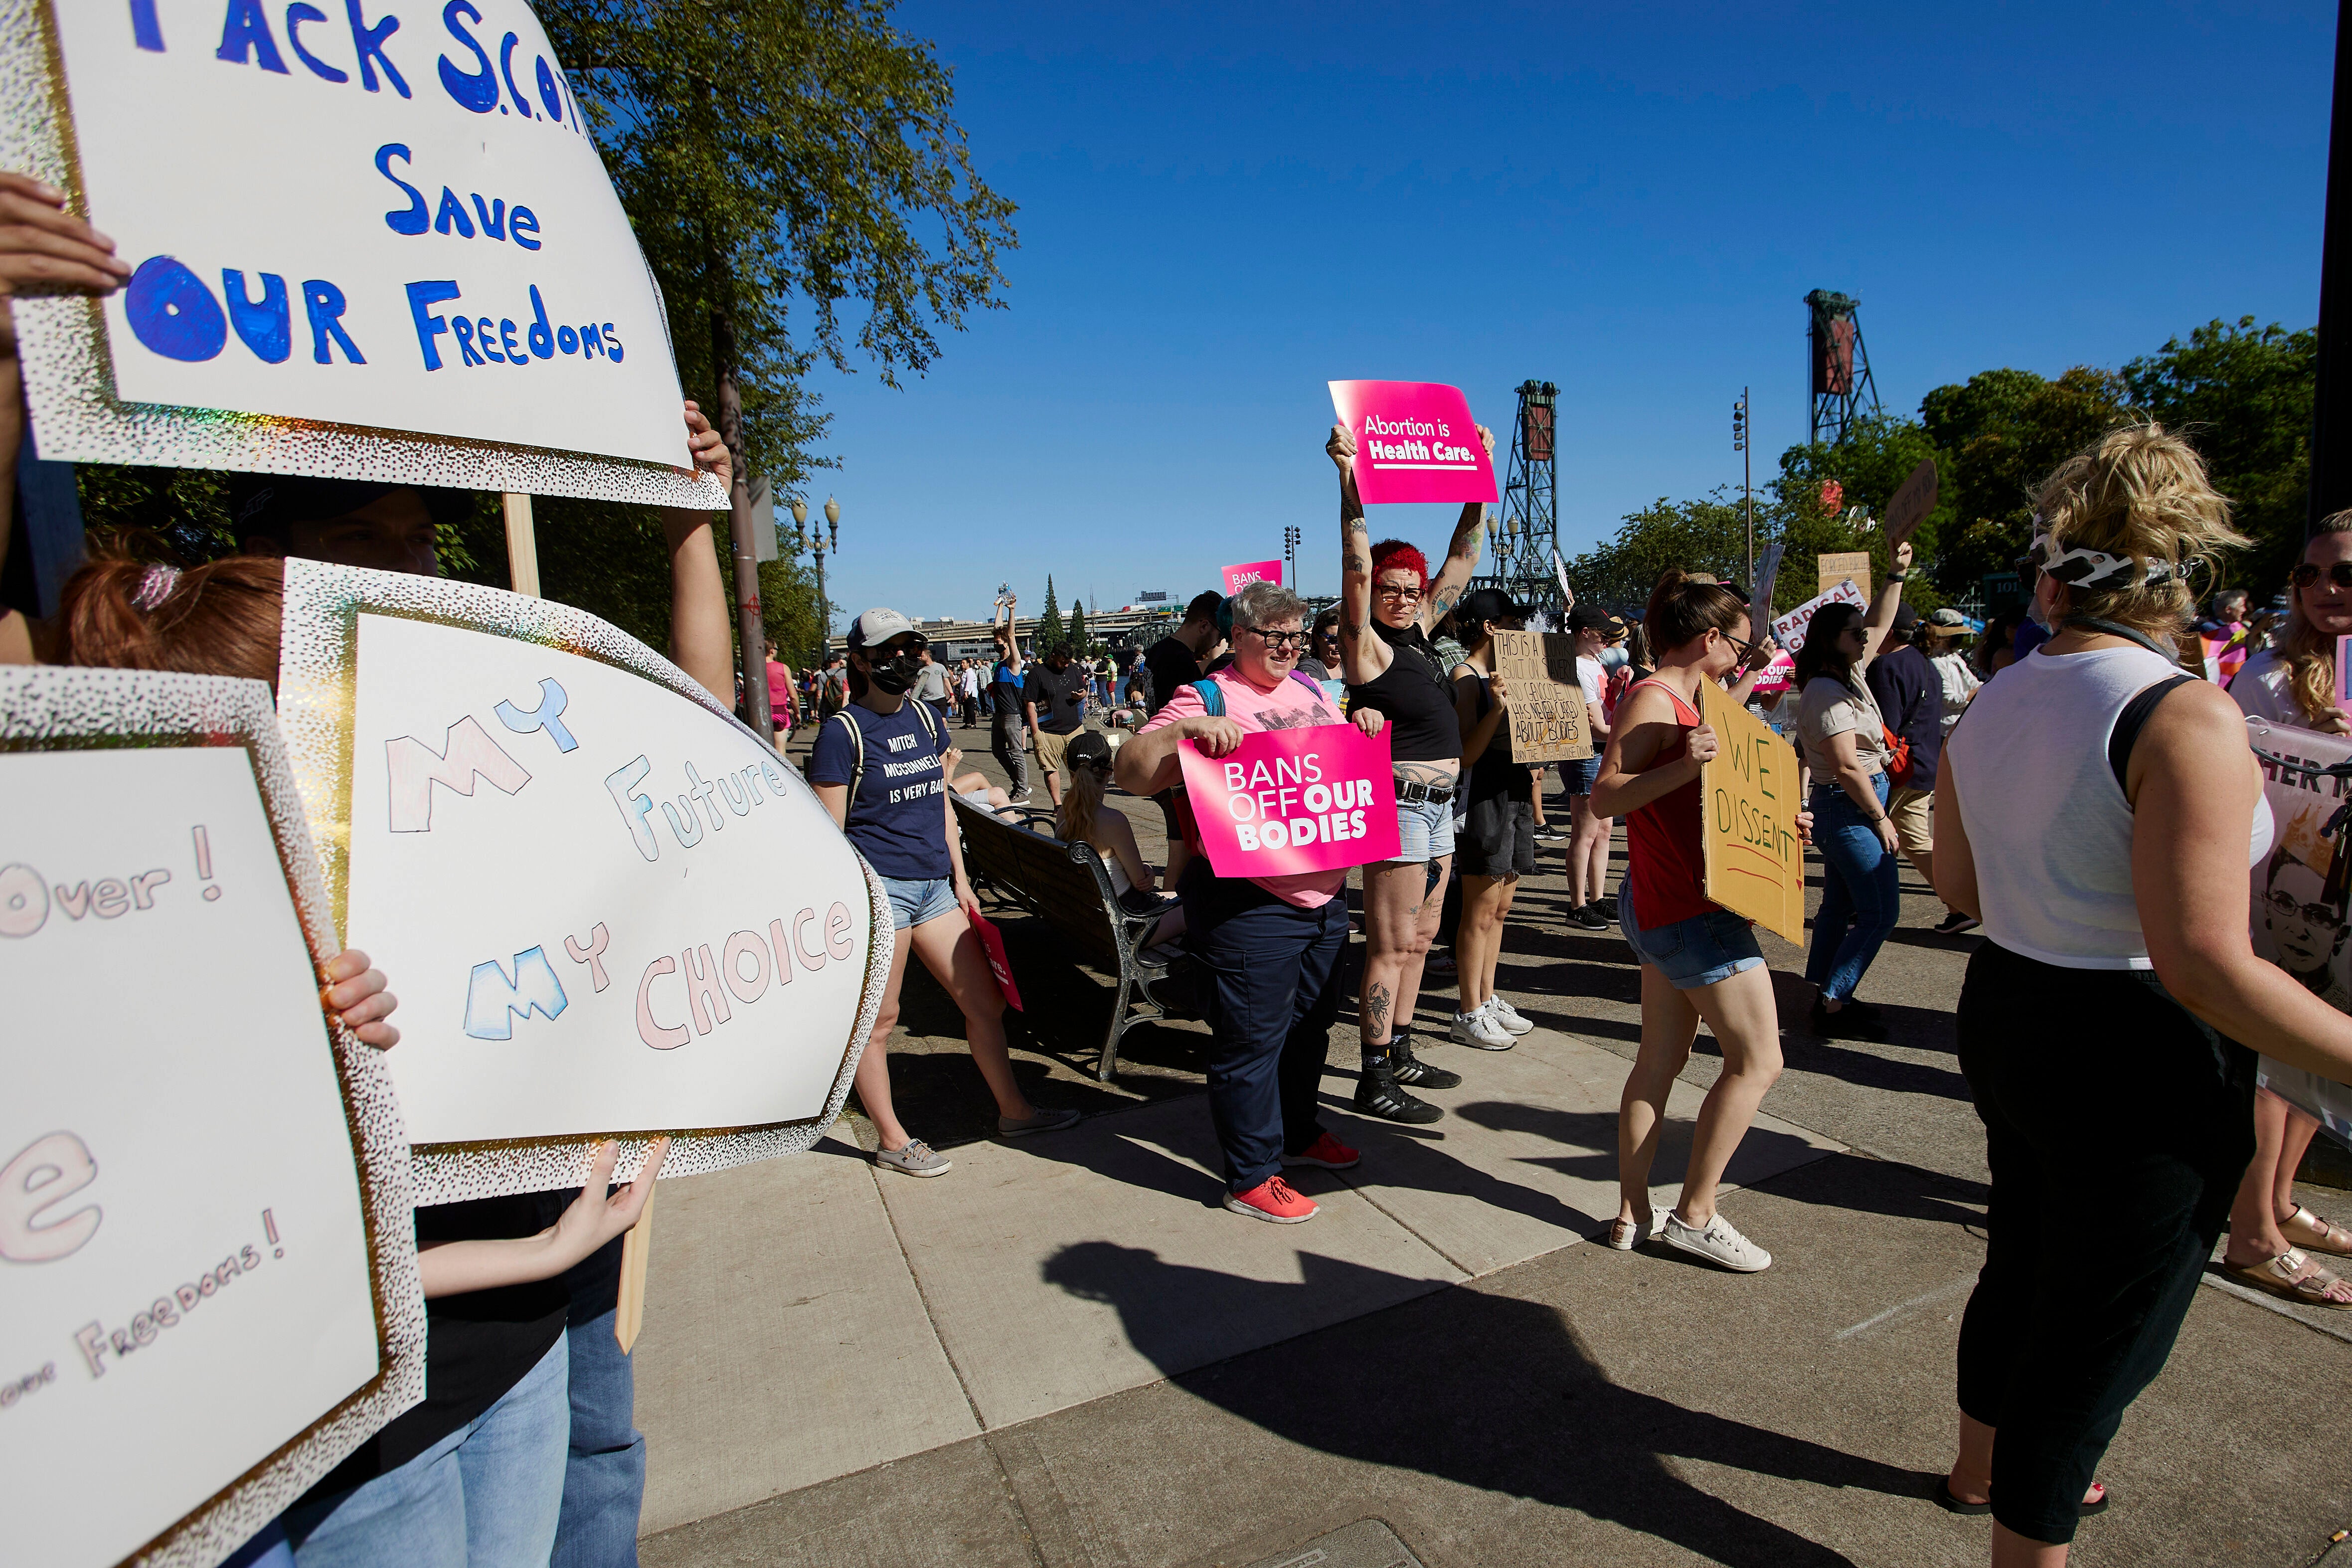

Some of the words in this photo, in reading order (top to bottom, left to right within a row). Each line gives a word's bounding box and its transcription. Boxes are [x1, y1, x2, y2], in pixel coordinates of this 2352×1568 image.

[126, 255, 367, 363] OUR
[1365, 415, 1435, 436] Abortion
[1437, 418, 1450, 437] is
[1368, 440, 1430, 460] Health
[1433, 441, 1475, 462] Care.
[1821, 557, 1848, 574] FORCED
[1232, 571, 1261, 585] BANS
[1997, 581, 2017, 593] 101
[1494, 633, 1518, 656] THIS
[1520, 635, 1530, 657] IS
[1533, 636, 1538, 656] A
[1541, 634, 1573, 658] COUNTRY
[1502, 658, 1524, 679] BUILT
[1528, 658, 1539, 679] ON
[1541, 658, 1571, 680] SLAVERY
[1755, 675, 1784, 685] ODIES
[1506, 683, 1523, 701] AND
[1511, 703, 1531, 720] HAS
[1529, 701, 1555, 720] NEVER
[1555, 701, 1578, 719] CARED
[1516, 720, 1543, 743] ABOUT
[1548, 720, 1579, 741] BODIES
[887, 733, 918, 753] MITCH
[1514, 750, 1526, 762] BURN
[1526, 748, 1539, 761] THE
[1562, 745, 1577, 759] HOUSE
[385, 677, 579, 833] MY
[883, 753, 942, 778] MCCONNELL
[1722, 711, 1776, 800] WE
[1224, 753, 1322, 791] BANS
[889, 789, 901, 804] IS
[903, 782, 928, 801] VERY
[1228, 787, 1298, 822] OFF
[1303, 779, 1375, 813] OUR
[604, 754, 787, 862] Future
[1235, 810, 1367, 852] BODIES
[1715, 788, 1795, 862] DISSENT
[464, 922, 610, 1041] MY
